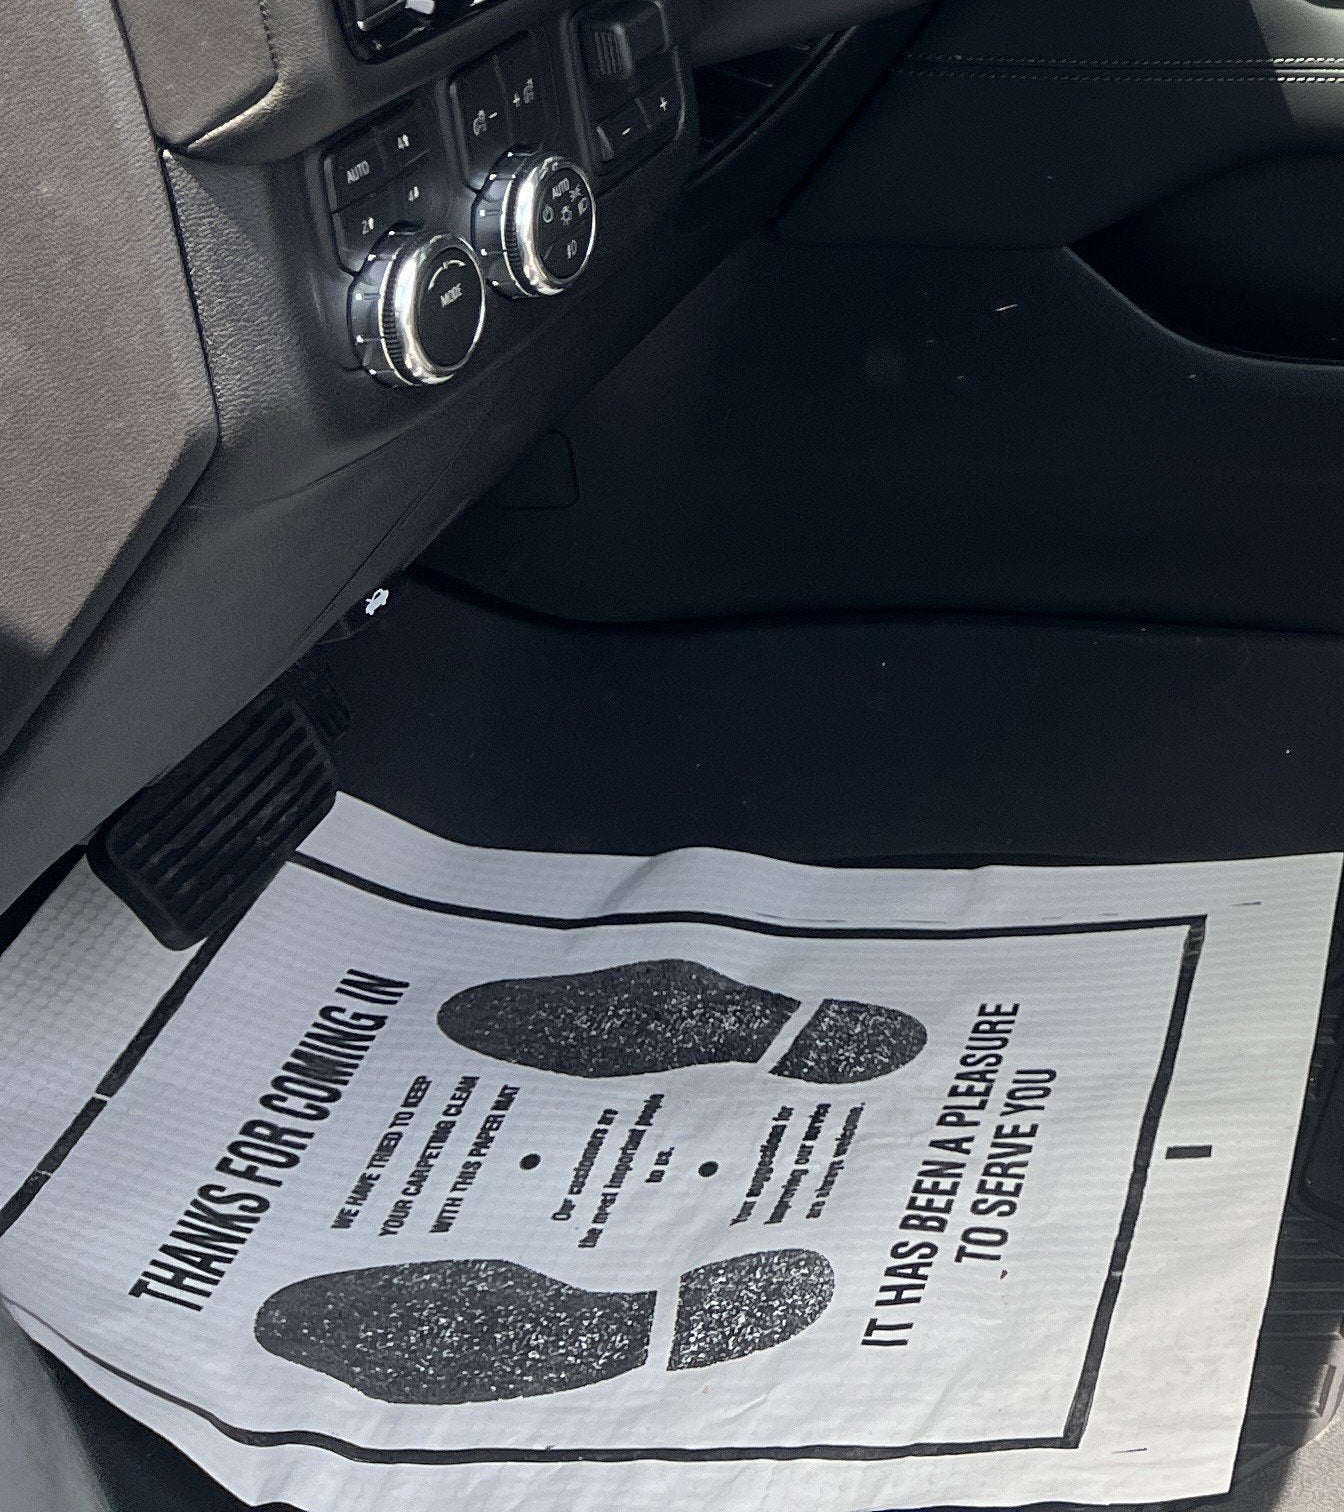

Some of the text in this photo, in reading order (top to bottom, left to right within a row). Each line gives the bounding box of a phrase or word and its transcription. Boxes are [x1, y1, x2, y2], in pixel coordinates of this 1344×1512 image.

[346, 160, 370, 184] AUTO
[552, 178, 570, 199] AUTO
[440, 283, 462, 308] MODE
[128, 969, 410, 1312] THANKS FOR COMING IN
[330, 1075, 433, 1229] WE HAVE TRIED TO KEEP
[378, 1076, 480, 1236] YOUR CARPETING CLEAN
[429, 1084, 520, 1233] WITH THIS PAPER MAT
[568, 1128, 609, 1195] customers
[729, 1105, 795, 1226] Your suggestions for
[794, 1144, 814, 1164] our
[802, 1103, 831, 1141] service
[954, 1069, 1057, 1263] TO SERVE YOU
[578, 1228, 604, 1248] the
[591, 1192, 618, 1223] most
[861, 1003, 1020, 1346] IT HAS BEEN A PLEASURE
